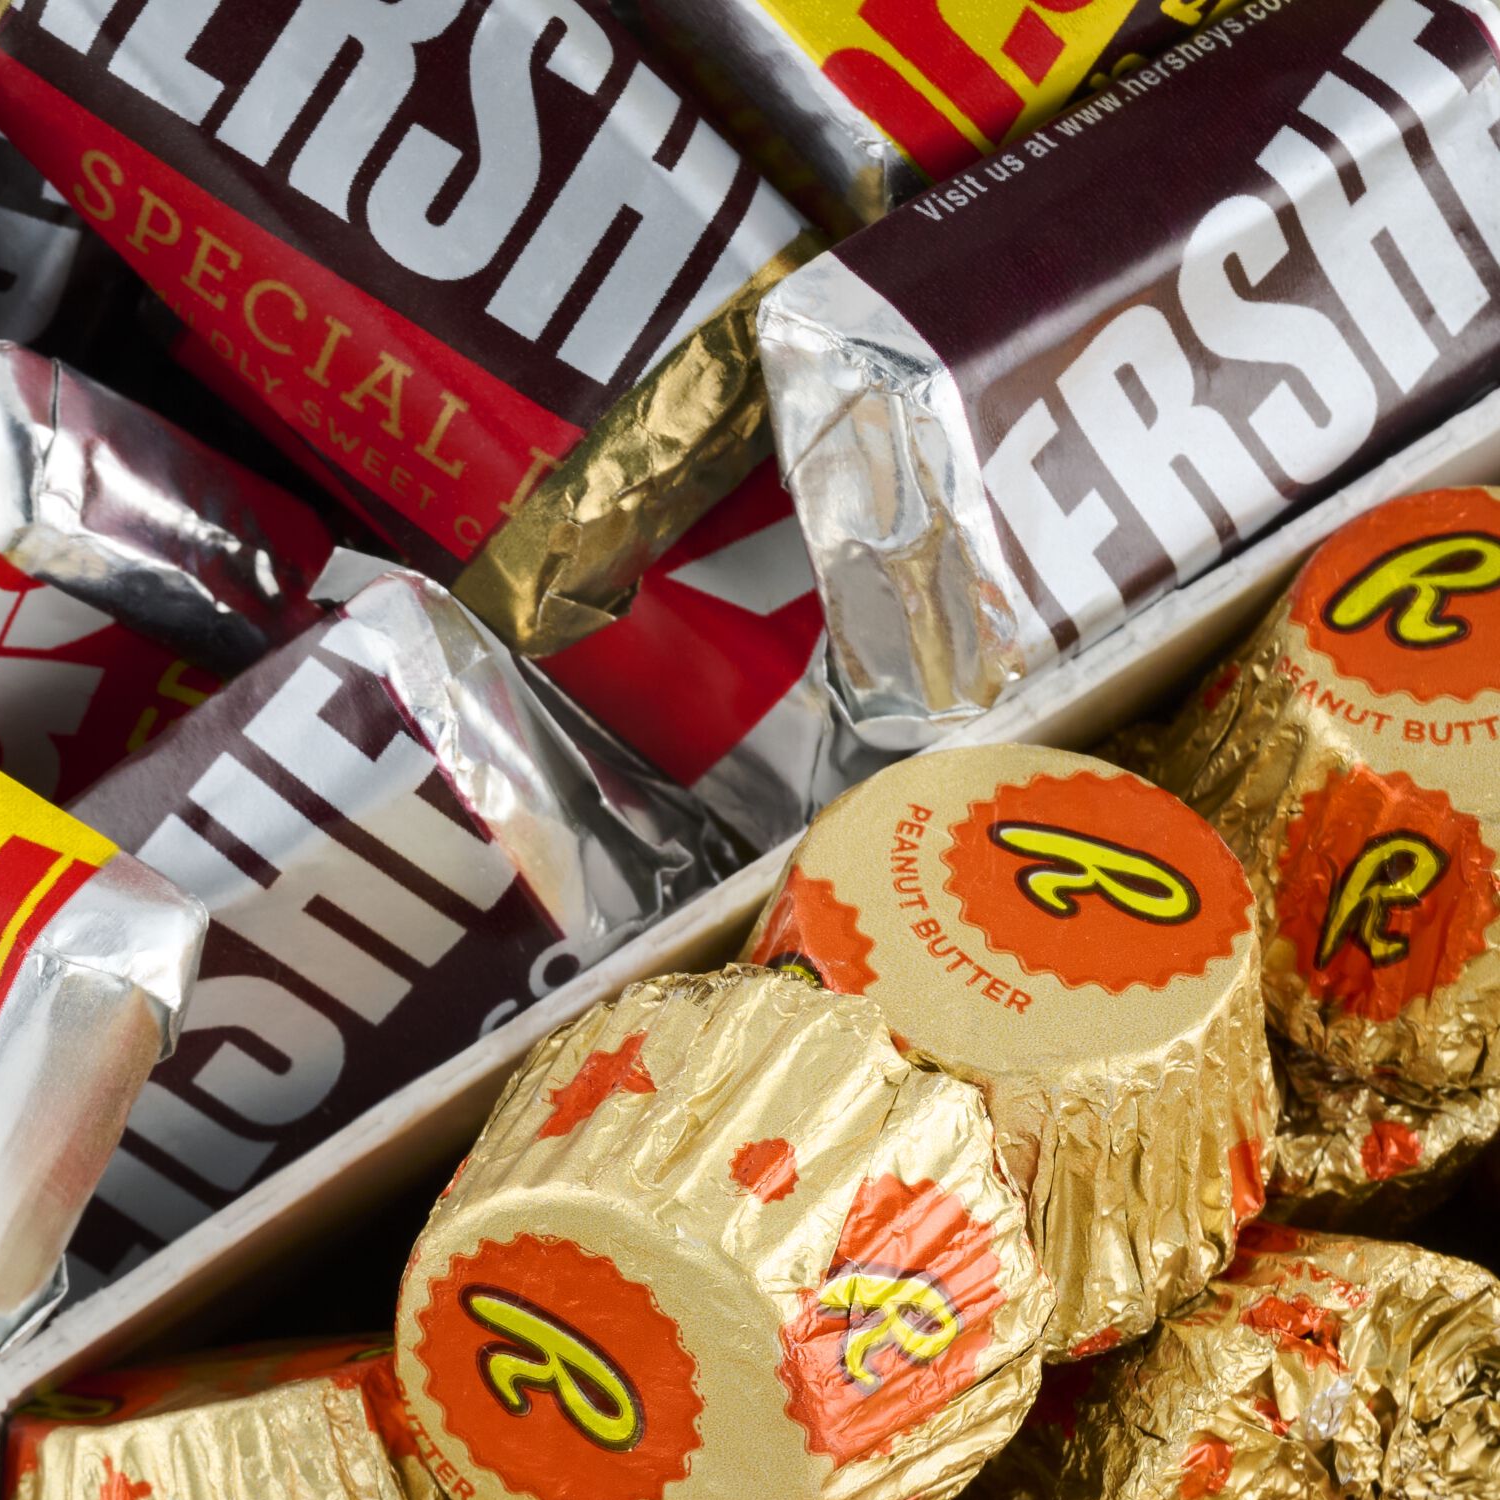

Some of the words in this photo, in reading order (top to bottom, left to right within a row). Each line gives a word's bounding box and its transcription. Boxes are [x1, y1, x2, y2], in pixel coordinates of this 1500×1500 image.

[914, 176, 989, 223] Visit
[985, 152, 1026, 184] us
[1023, 131, 1059, 161] at
[1053, 0, 1293, 139] www.hersheys.co
[74, 149, 471, 481] SPECIAL
[299, 401, 437, 510] SWEET
[890, 802, 934, 912] PEANUT
[910, 916, 1034, 1015] BUTTER
